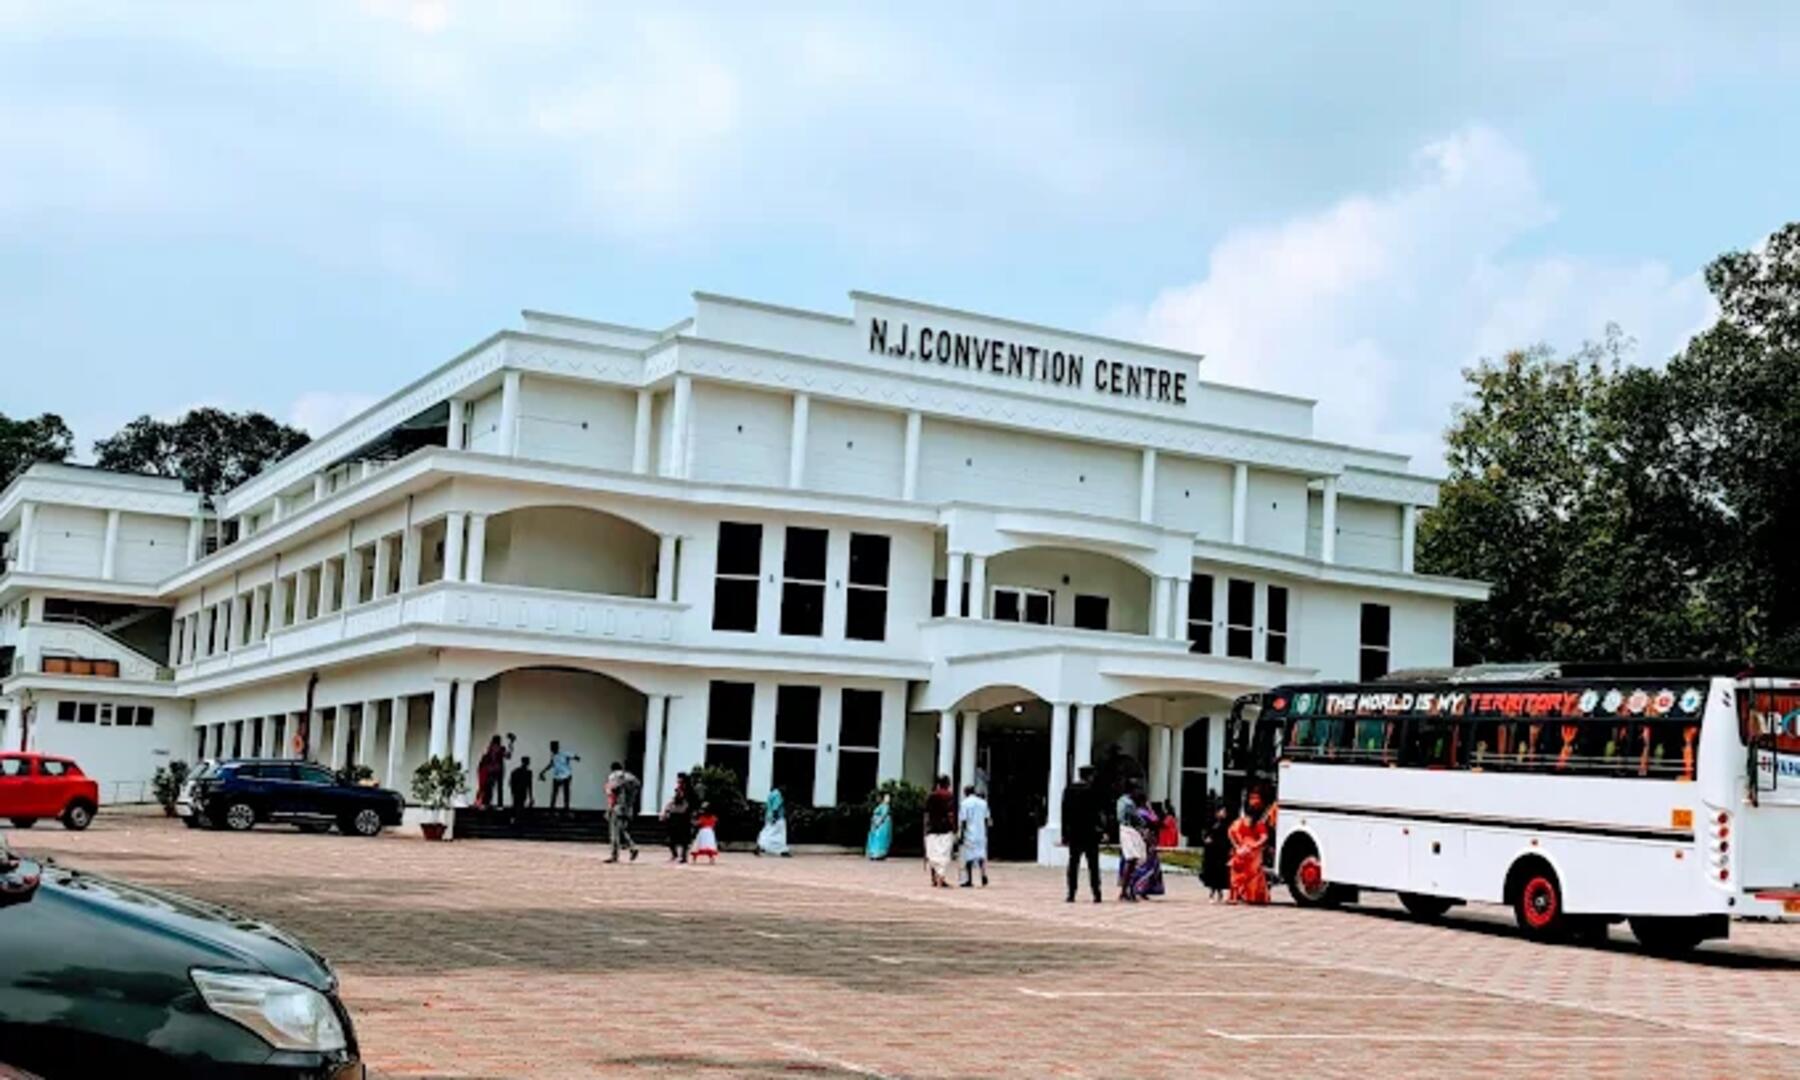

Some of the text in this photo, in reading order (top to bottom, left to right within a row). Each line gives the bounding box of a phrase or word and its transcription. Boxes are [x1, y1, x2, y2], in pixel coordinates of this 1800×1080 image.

[1095, 358, 1187, 404] CENTRE
[1326, 691, 1582, 716] THE WORLD IS MY TERRITORY
